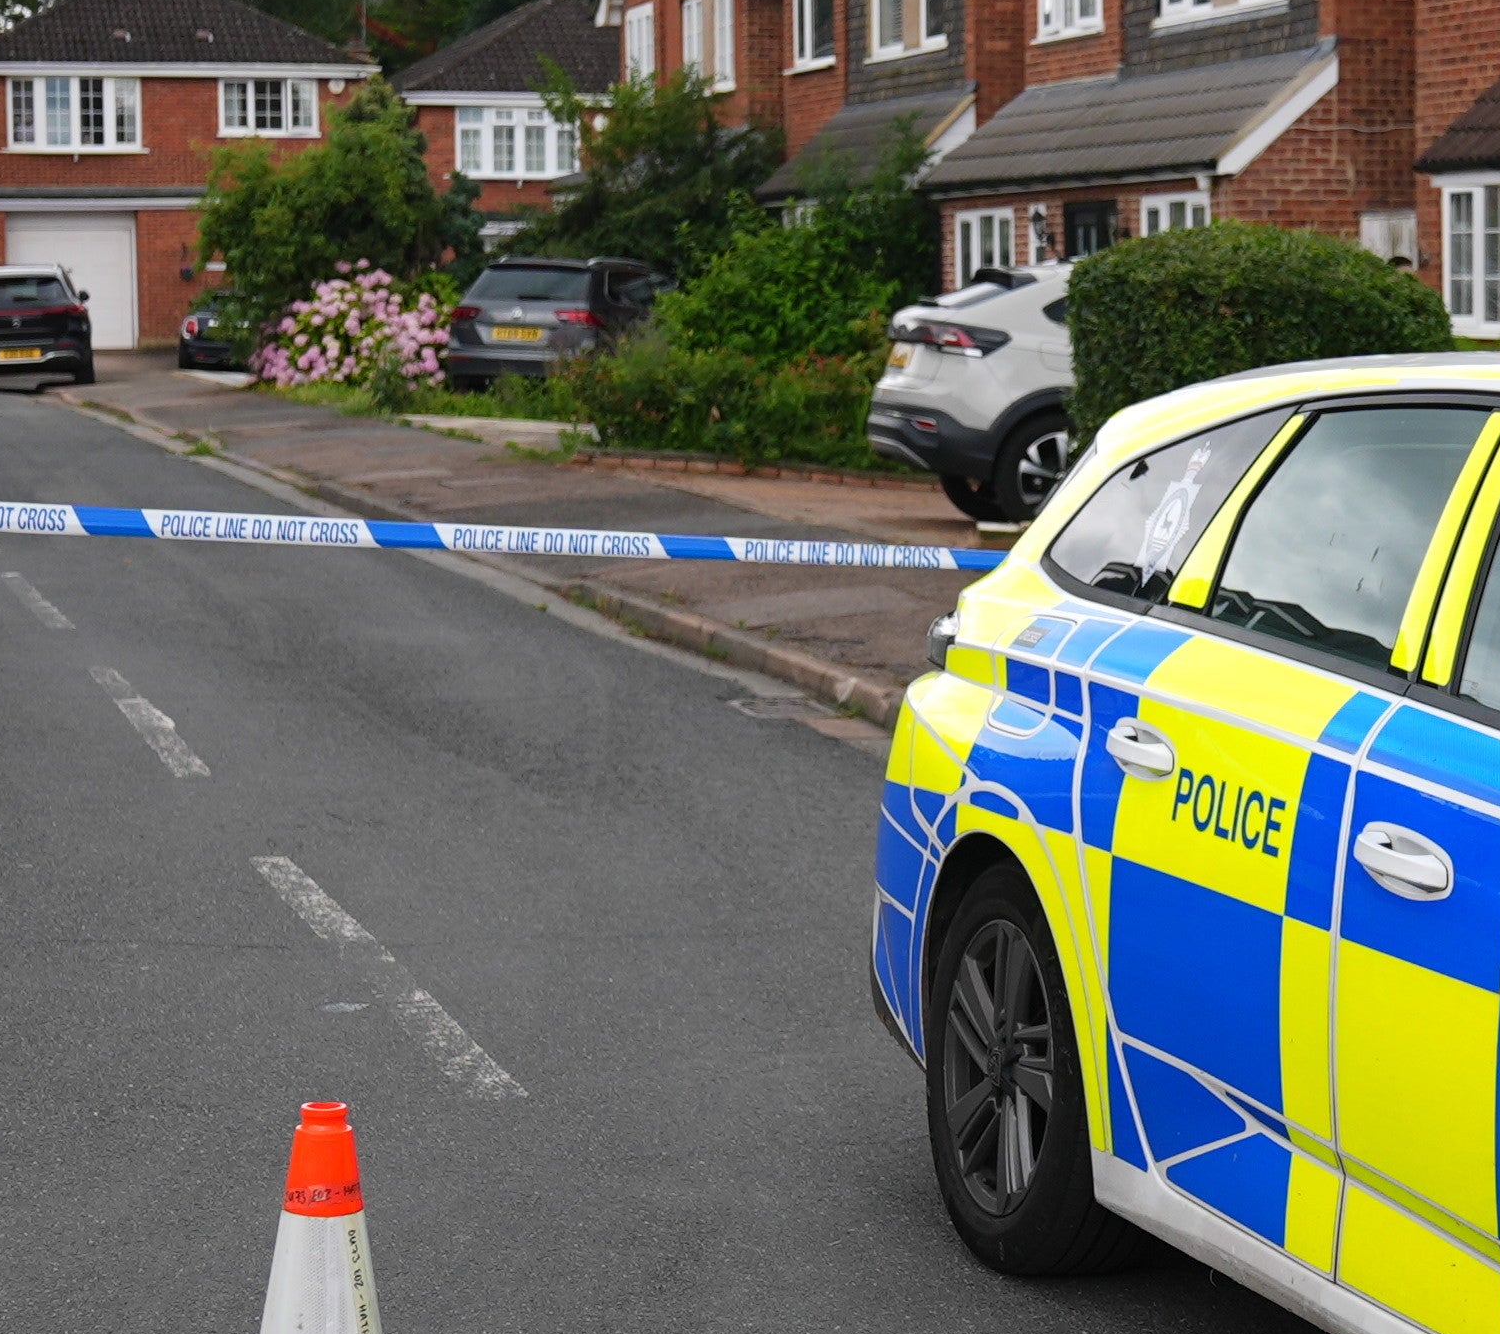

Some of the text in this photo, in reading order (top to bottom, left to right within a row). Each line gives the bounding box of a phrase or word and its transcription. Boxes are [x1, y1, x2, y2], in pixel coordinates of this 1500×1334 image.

[17, 507, 66, 532] CROSS
[160, 514, 358, 545] POLICE LINE DO NOT CROSS
[453, 528, 649, 556] POLICE LINE DO NOT CROSS
[744, 540, 794, 560] POLICE
[799, 543, 830, 562] LINE
[835, 544, 855, 563] DO
[1171, 767, 1286, 857] POLICE
